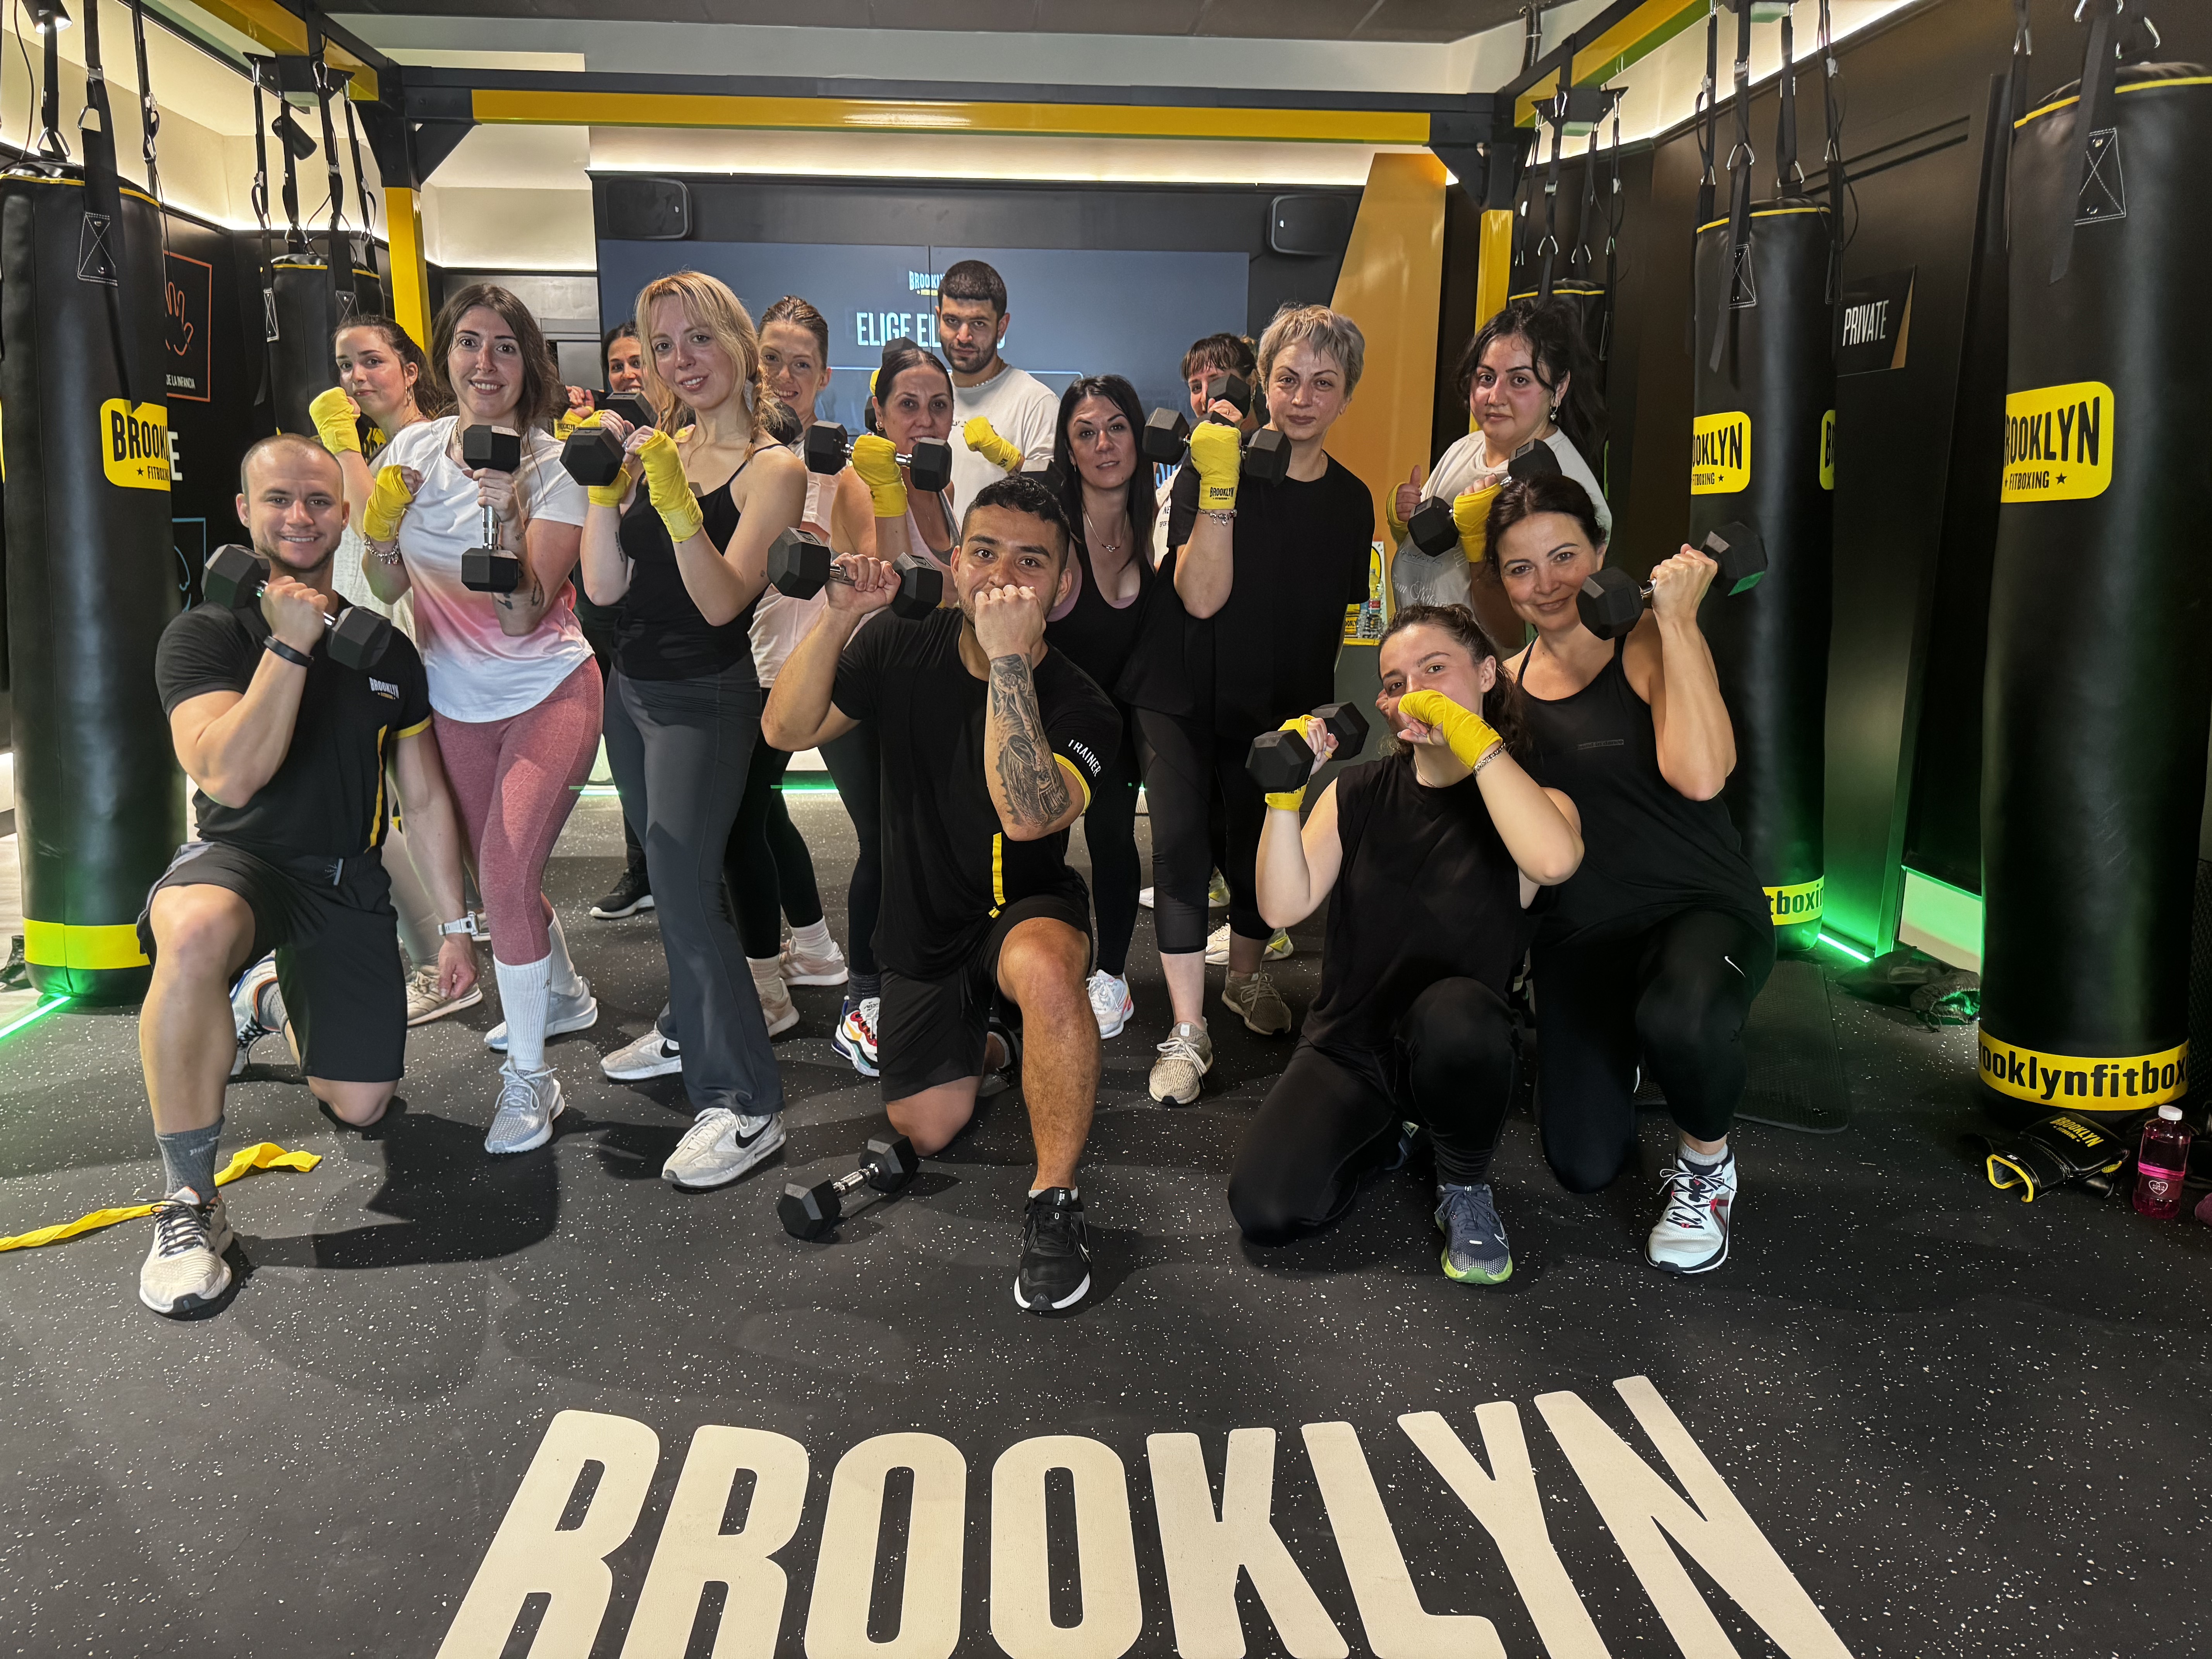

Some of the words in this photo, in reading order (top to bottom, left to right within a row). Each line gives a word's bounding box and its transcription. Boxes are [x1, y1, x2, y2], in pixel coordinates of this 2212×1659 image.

[916, 313, 942, 348] EL
[1843, 300, 1889, 346] PRIVATE
[1209, 486, 1235, 497] BROOKLYN
[2009, 471, 2049, 491] FITBOXING
[369, 677, 399, 699] BROOKLYN
[2049, 1117, 2104, 1147] BROOKLYN
[434, 1375, 1855, 1659] BROOKLYN
